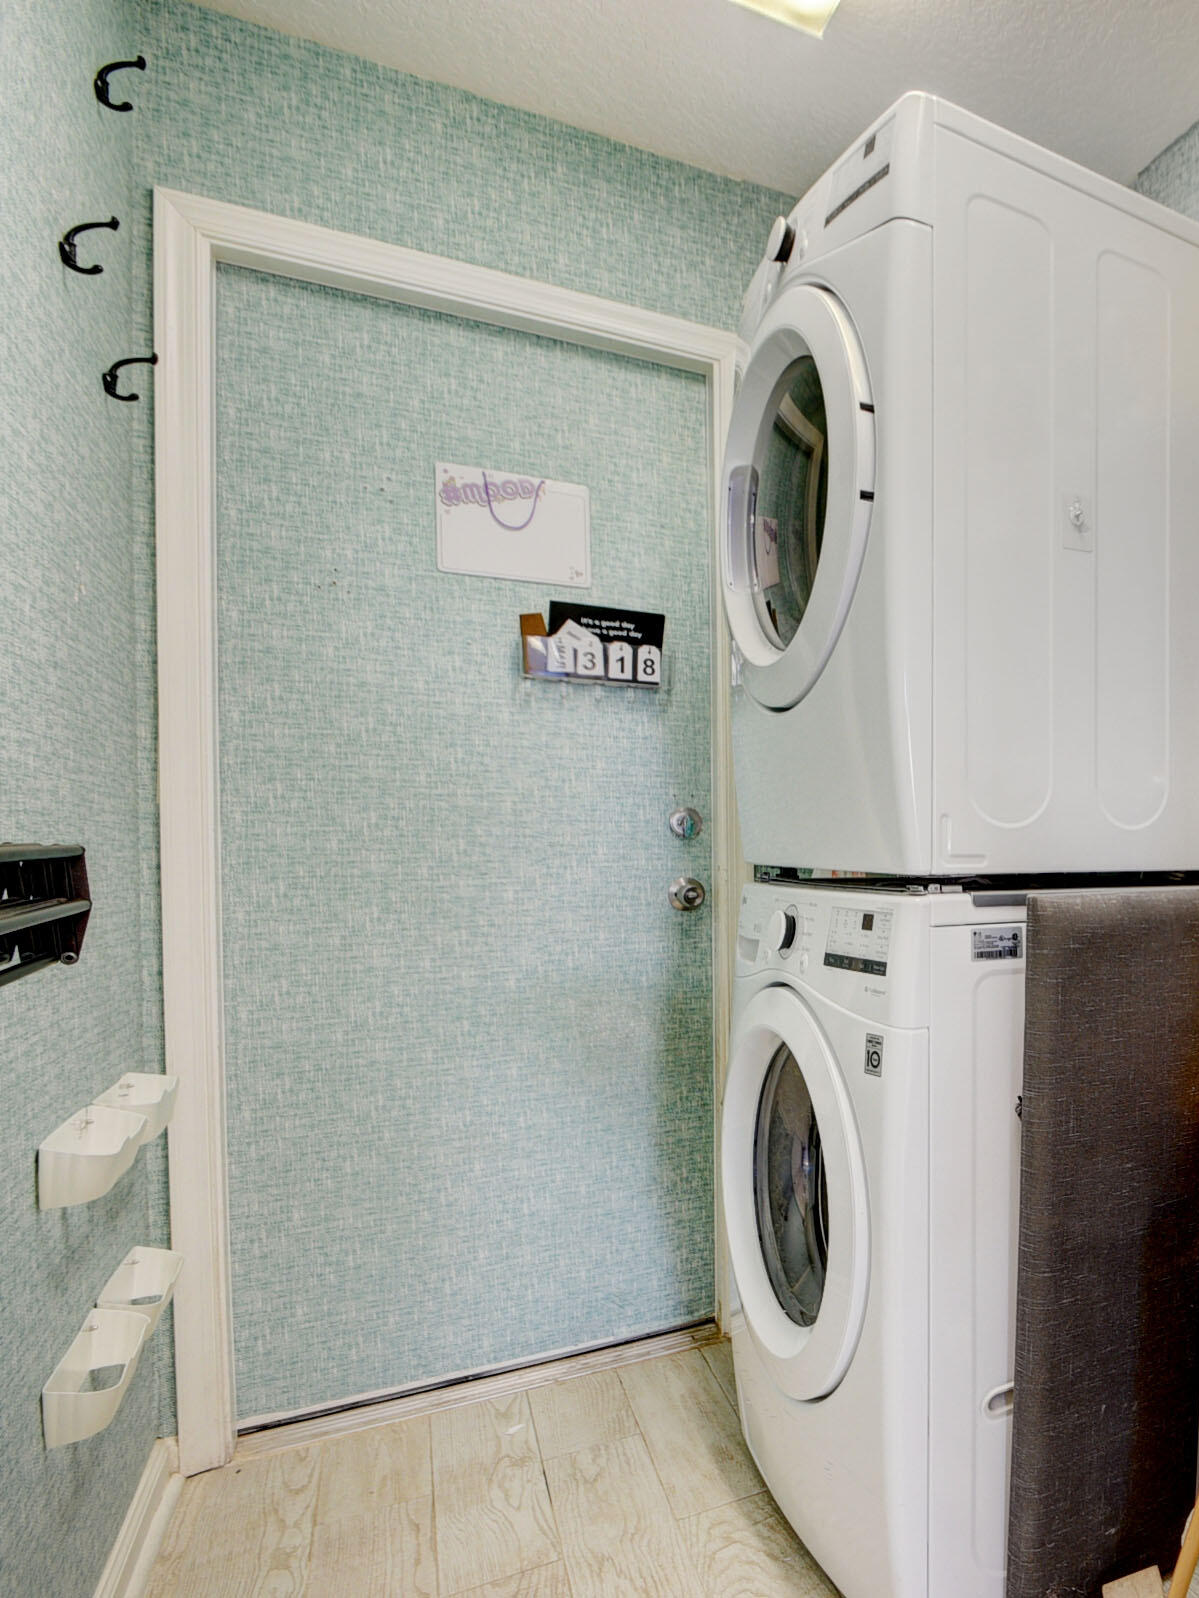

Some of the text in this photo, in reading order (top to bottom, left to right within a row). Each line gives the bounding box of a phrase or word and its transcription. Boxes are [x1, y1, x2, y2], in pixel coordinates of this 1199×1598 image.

[601, 620, 620, 628] good
[621, 621, 635, 630] day
[608, 629, 627, 637] good
[628, 630, 642, 639] day
[583, 652, 596, 671] 3
[615, 656, 625, 674] 1
[643, 658, 655, 676] 8
[866, 1049, 881, 1068] 10
